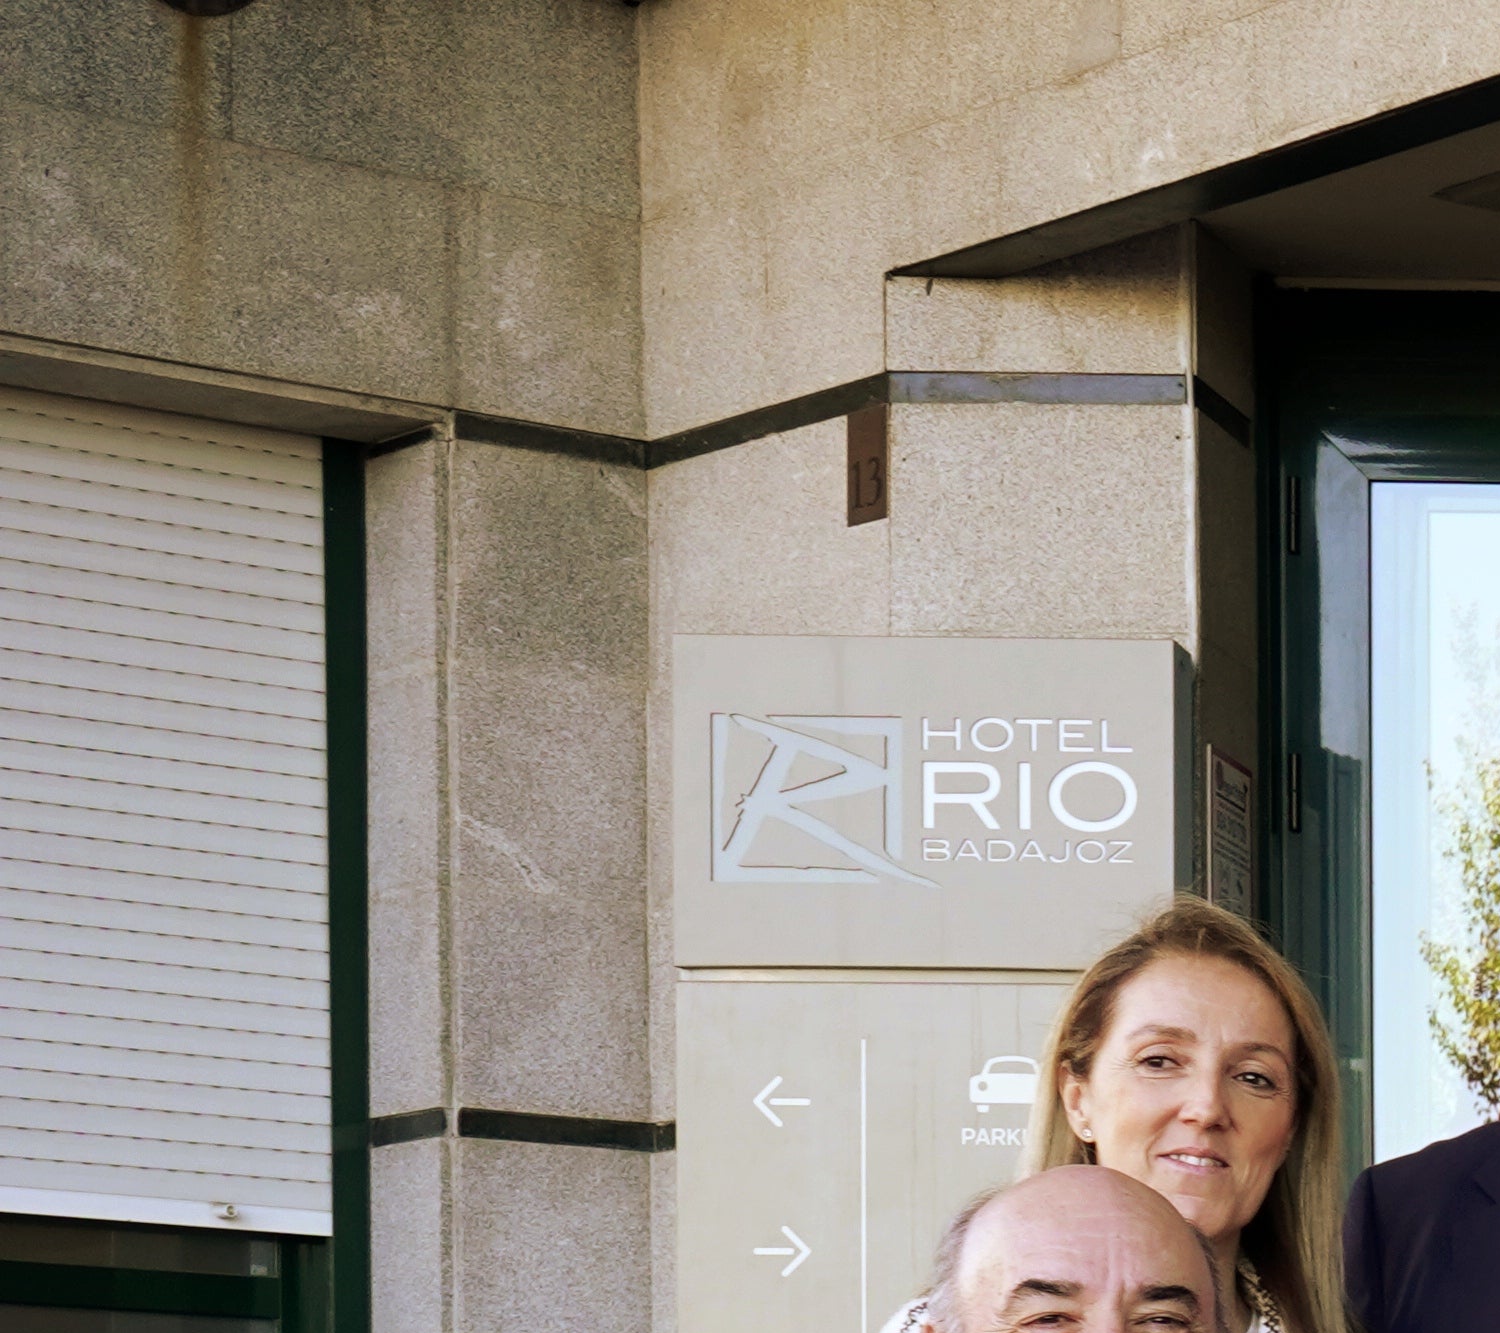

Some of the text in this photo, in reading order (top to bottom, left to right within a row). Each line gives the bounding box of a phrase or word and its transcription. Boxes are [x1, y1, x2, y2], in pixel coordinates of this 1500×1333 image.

[853, 456, 881, 509] 13
[921, 717, 1134, 752] HOTEL
[921, 761, 1138, 833] RIO
[921, 838, 1134, 864] BADAJOZ
[961, 1127, 1027, 1146] PARKI
